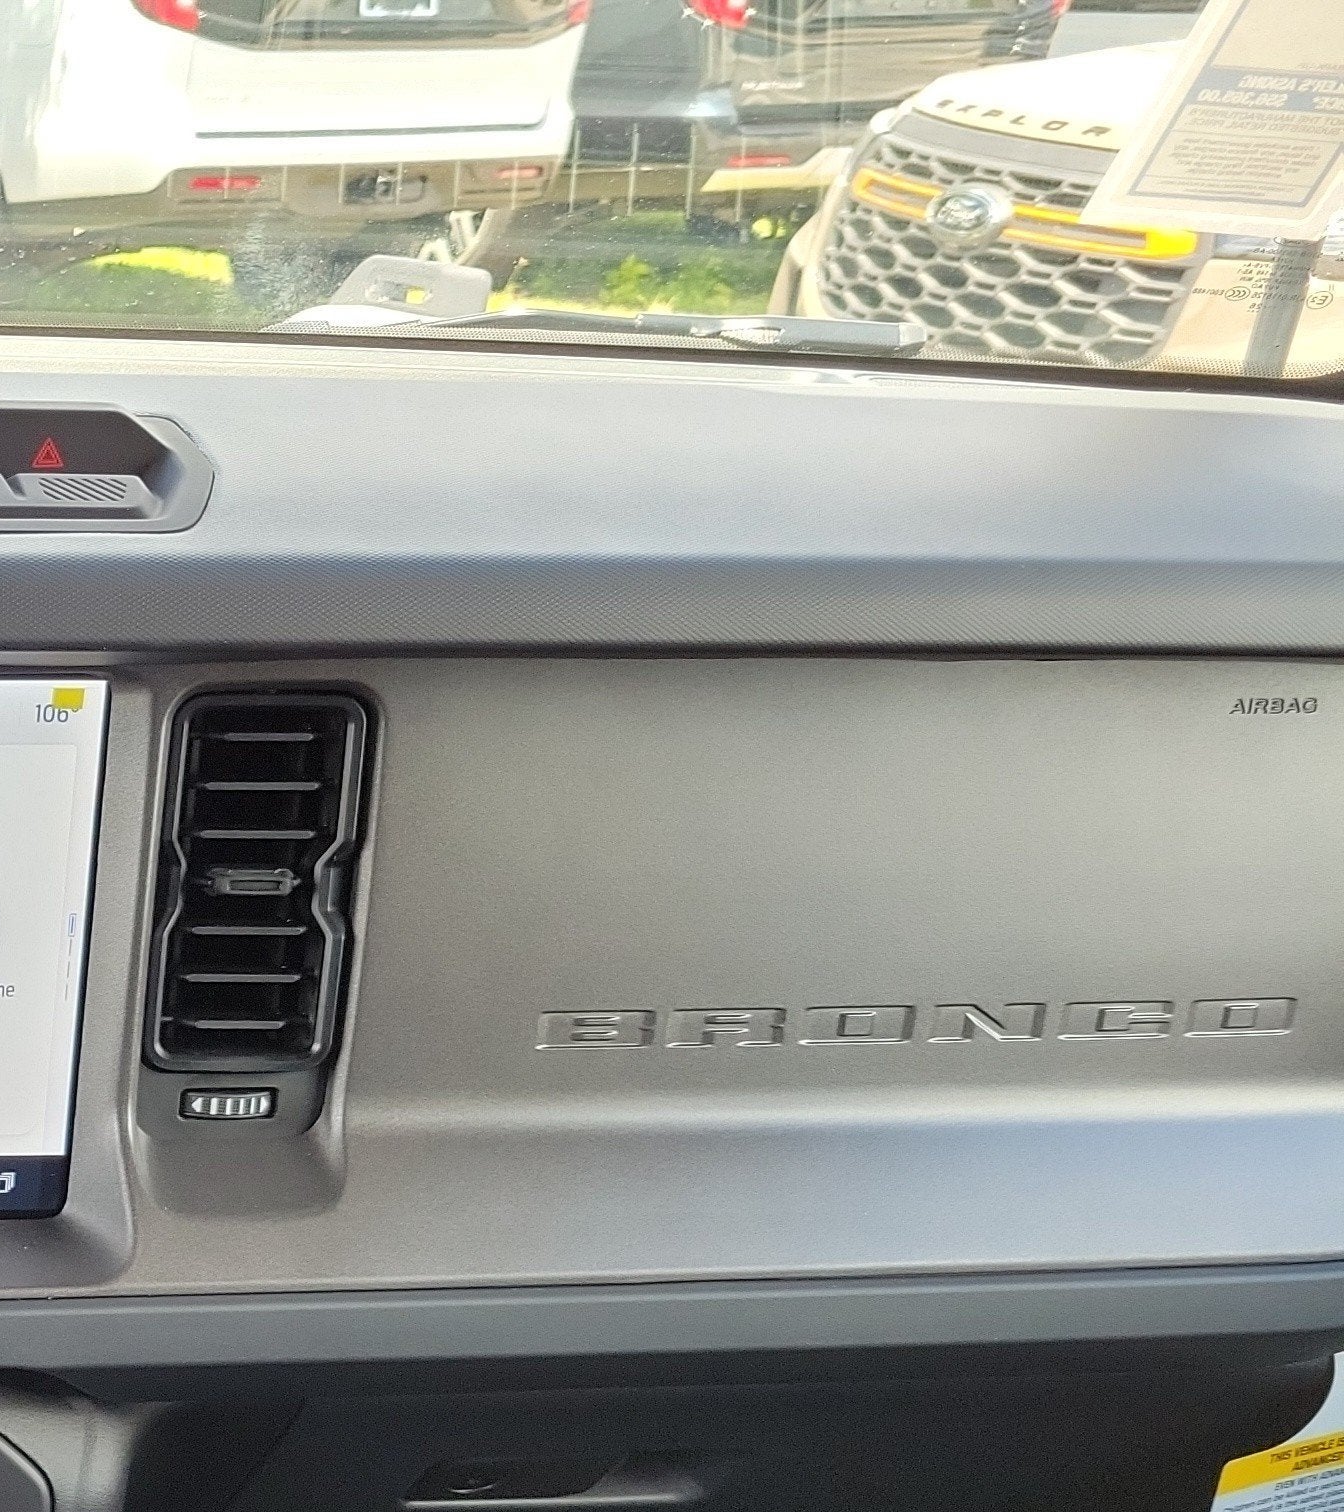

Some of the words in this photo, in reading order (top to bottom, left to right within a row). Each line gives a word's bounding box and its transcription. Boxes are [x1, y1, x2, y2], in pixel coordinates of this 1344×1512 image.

[935, 99, 1112, 139] EXPLOR
[1229, 697, 1318, 715] AIRBAG
[535, 996, 1300, 1052] BRONCO
